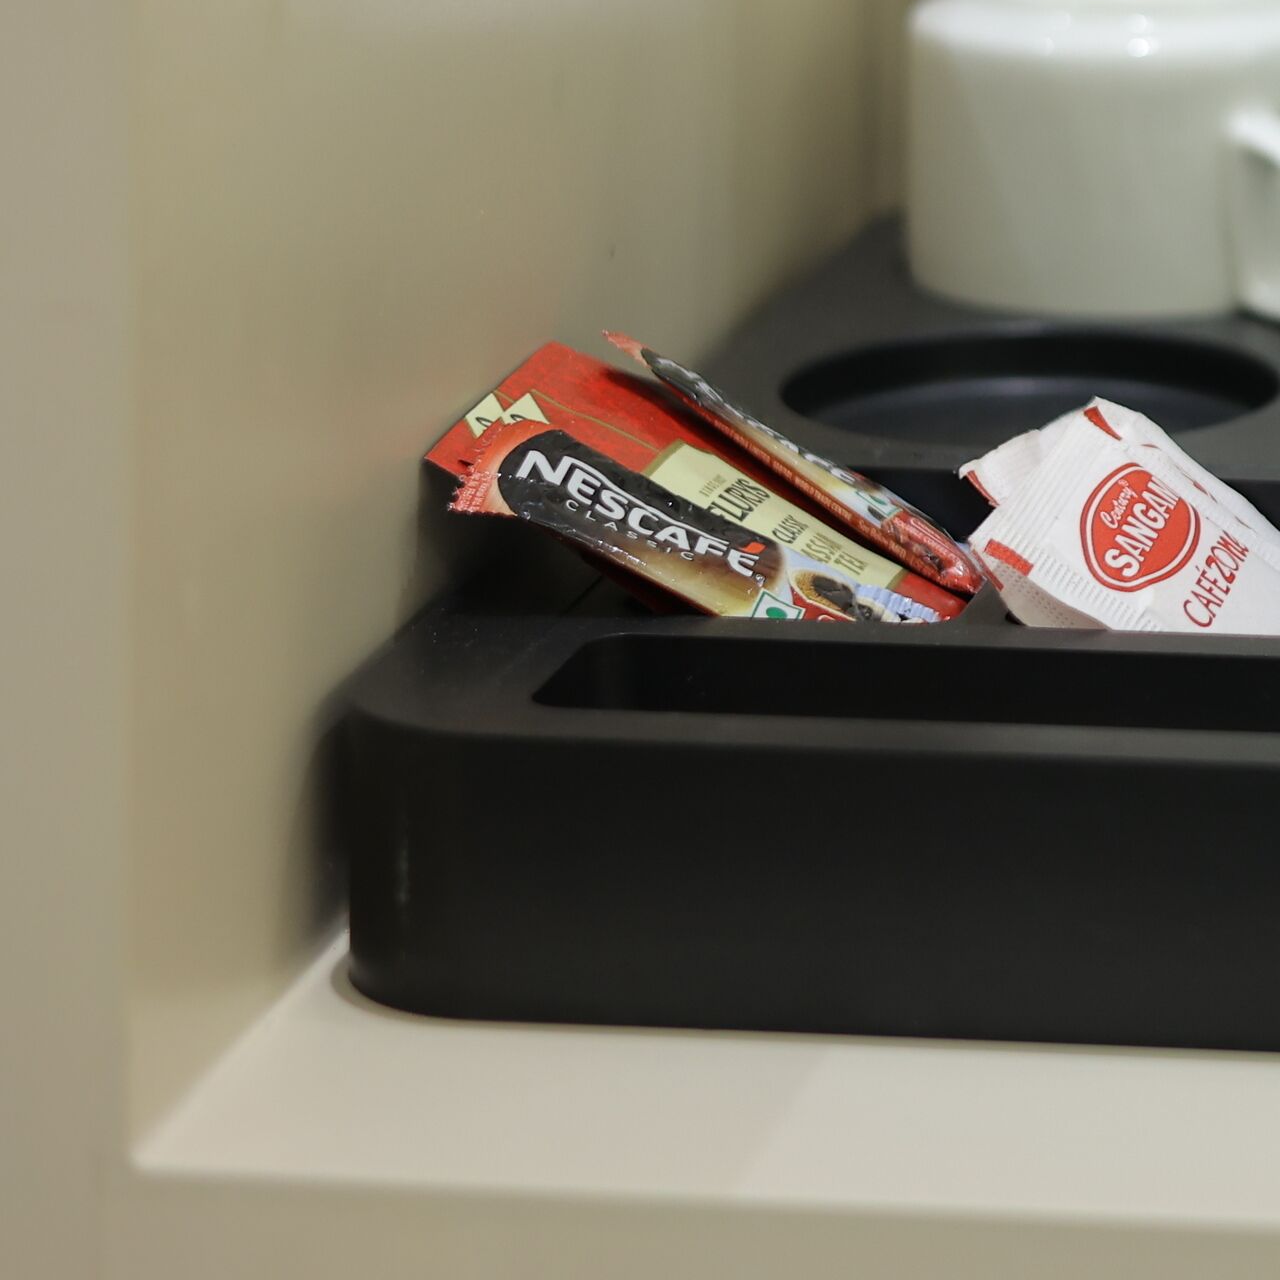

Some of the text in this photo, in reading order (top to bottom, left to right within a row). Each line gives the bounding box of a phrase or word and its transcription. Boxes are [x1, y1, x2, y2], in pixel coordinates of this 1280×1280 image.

[516, 449, 768, 577] NESCAFÉ
[566, 499, 694, 562] CLASSIC
[1100, 485, 1139, 529] Century
